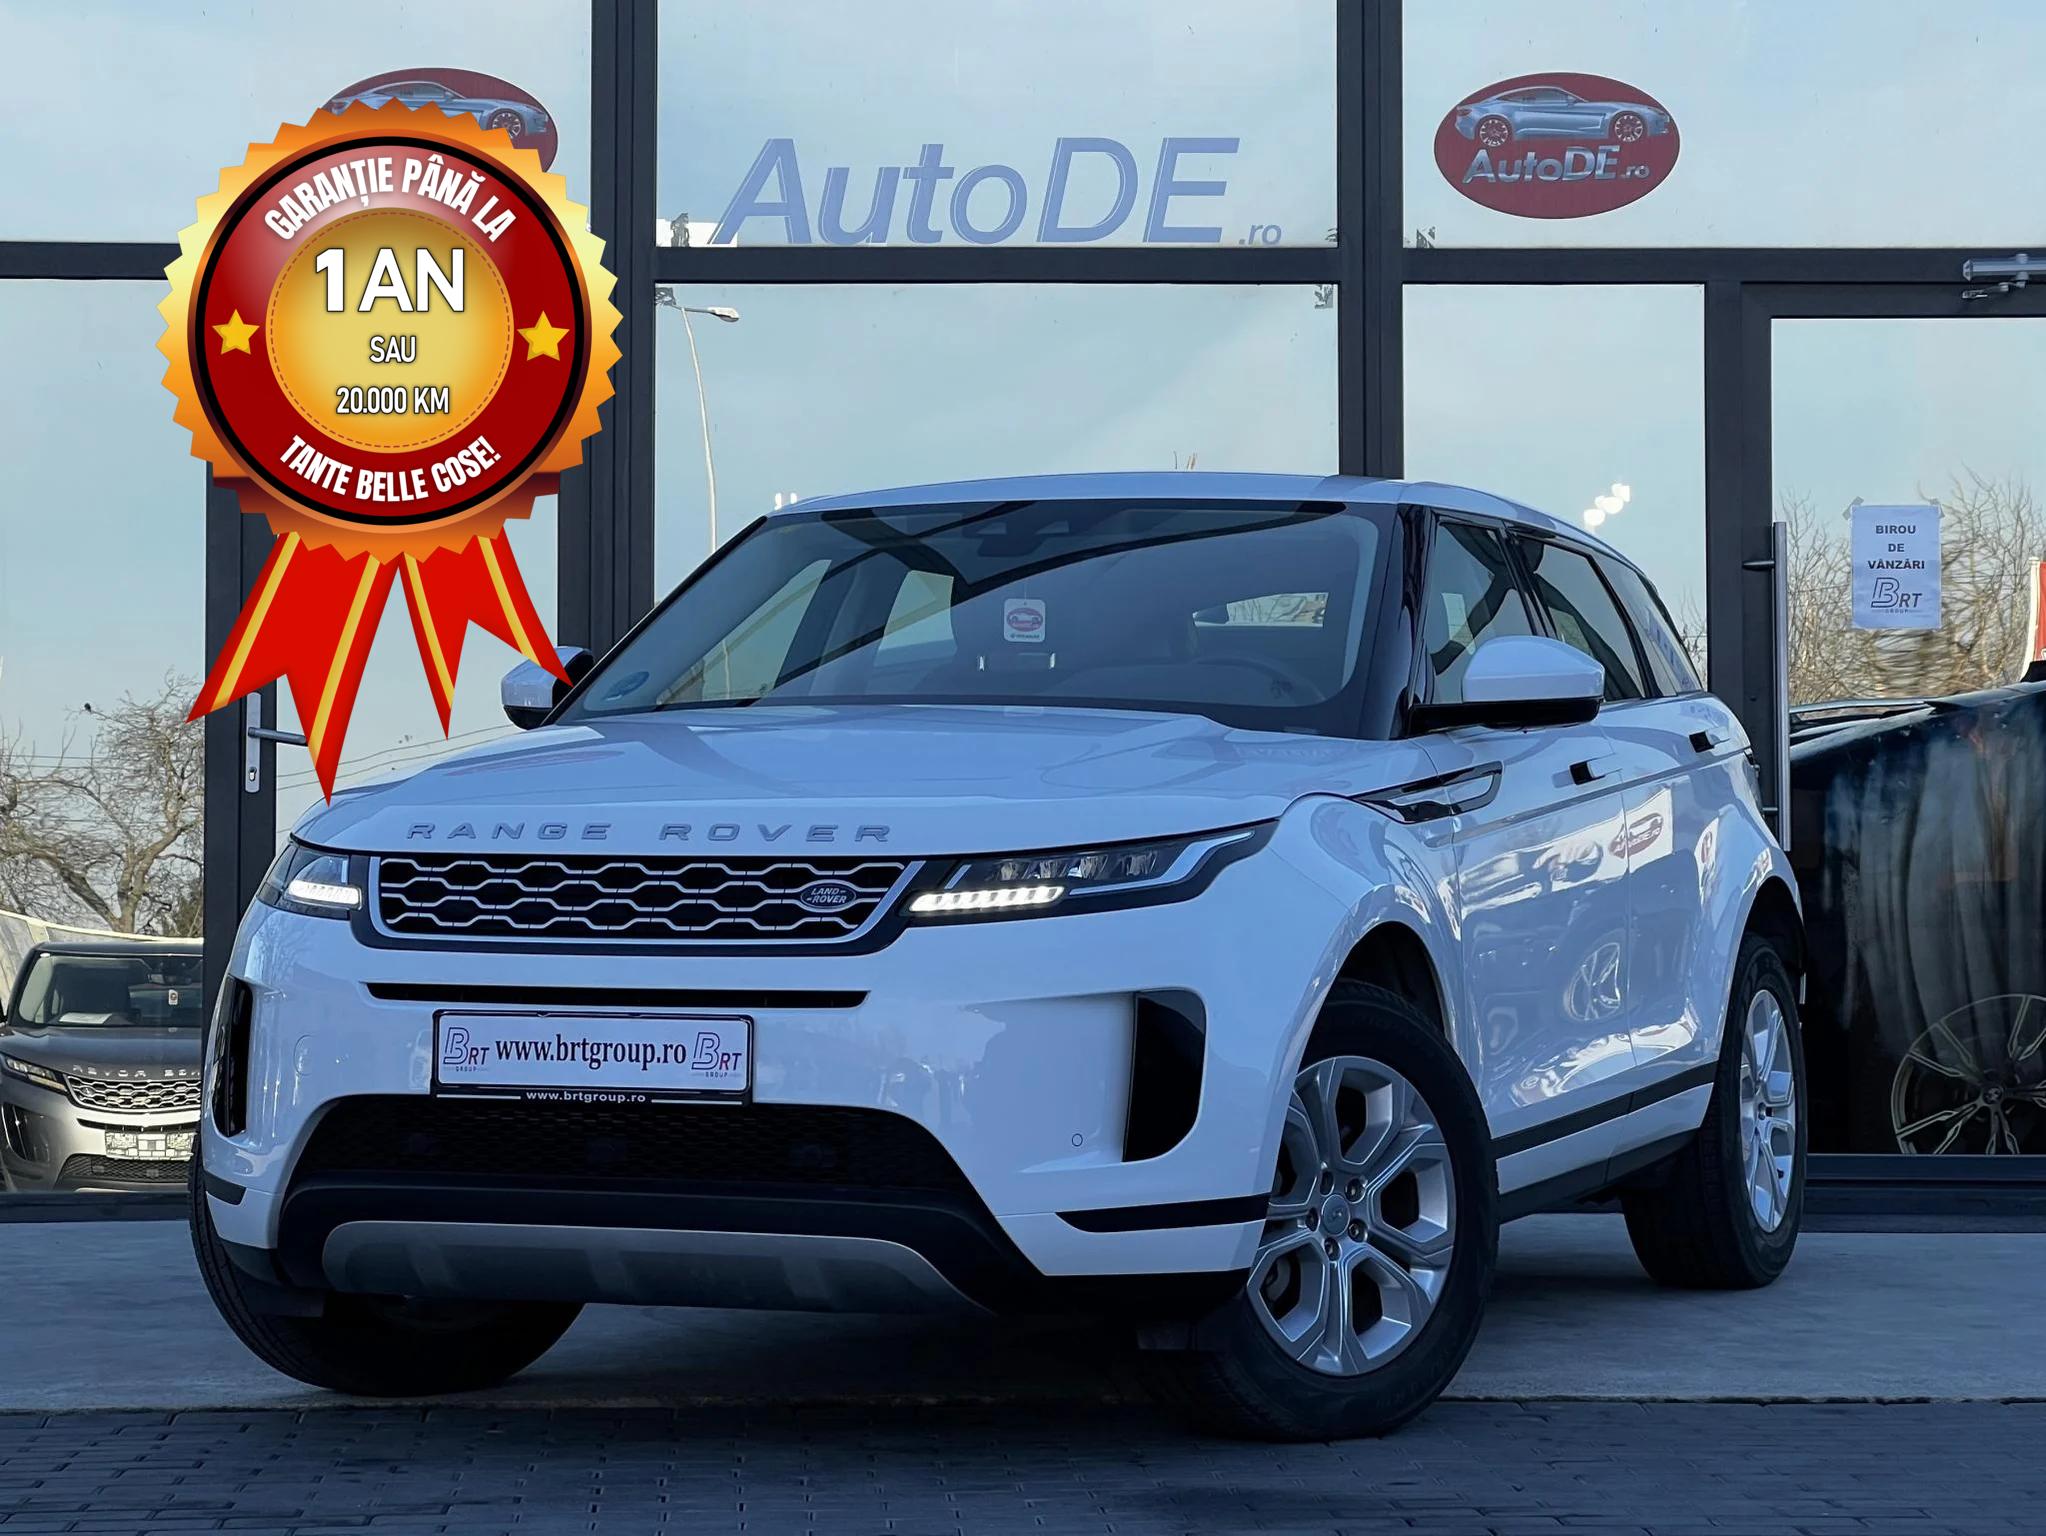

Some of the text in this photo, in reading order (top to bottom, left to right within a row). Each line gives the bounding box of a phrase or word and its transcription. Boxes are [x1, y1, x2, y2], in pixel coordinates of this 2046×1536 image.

[1875, 525, 1916, 534] BIROU
[1888, 543, 1905, 552] DE
[407, 822, 891, 842] RANGE ROVER
[496, 1034, 686, 1071] www.brtgroup.ro
[526, 1090, 646, 1104] www.brtgroup.ro
